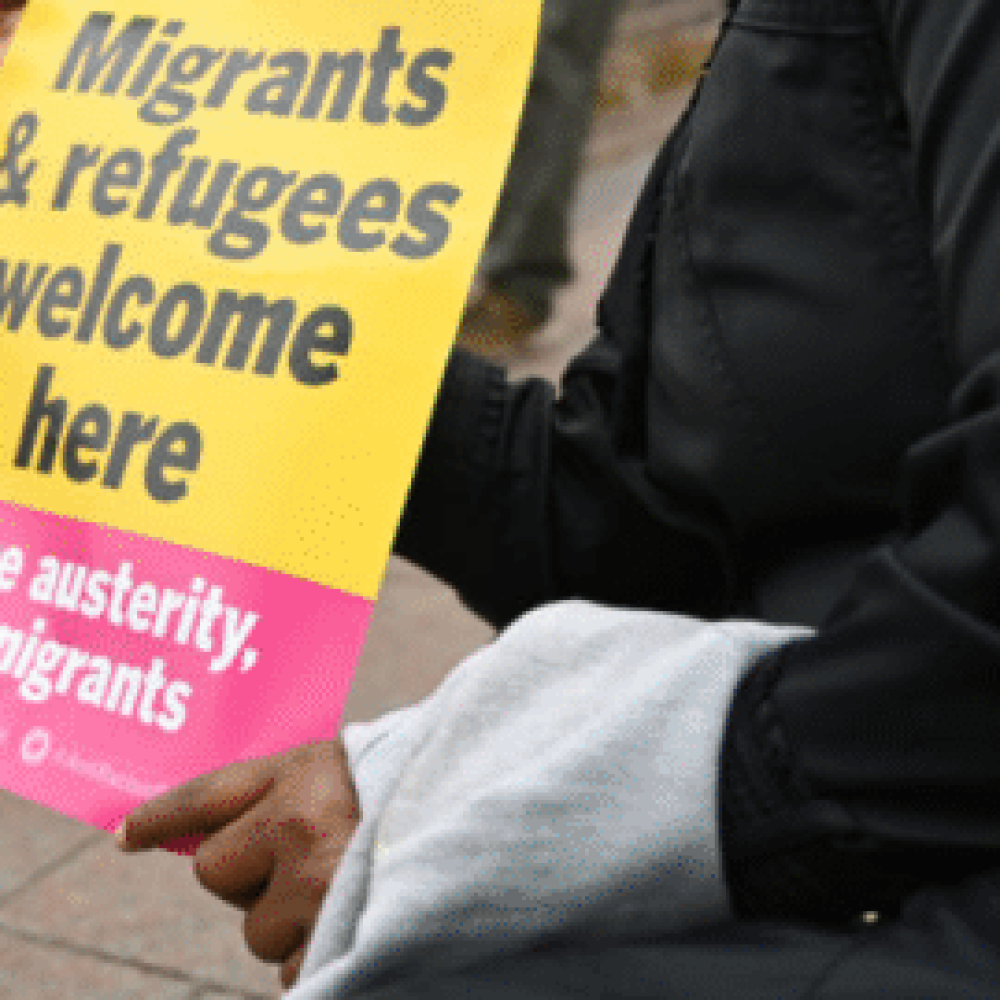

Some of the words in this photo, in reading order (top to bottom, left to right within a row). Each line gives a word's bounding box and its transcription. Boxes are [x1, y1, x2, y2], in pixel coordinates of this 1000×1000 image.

[53, 11, 455, 127] Migrants
[52, 128, 462, 260] refugees
[13, 364, 204, 504] here
[29, 556, 261, 674] austerity,
